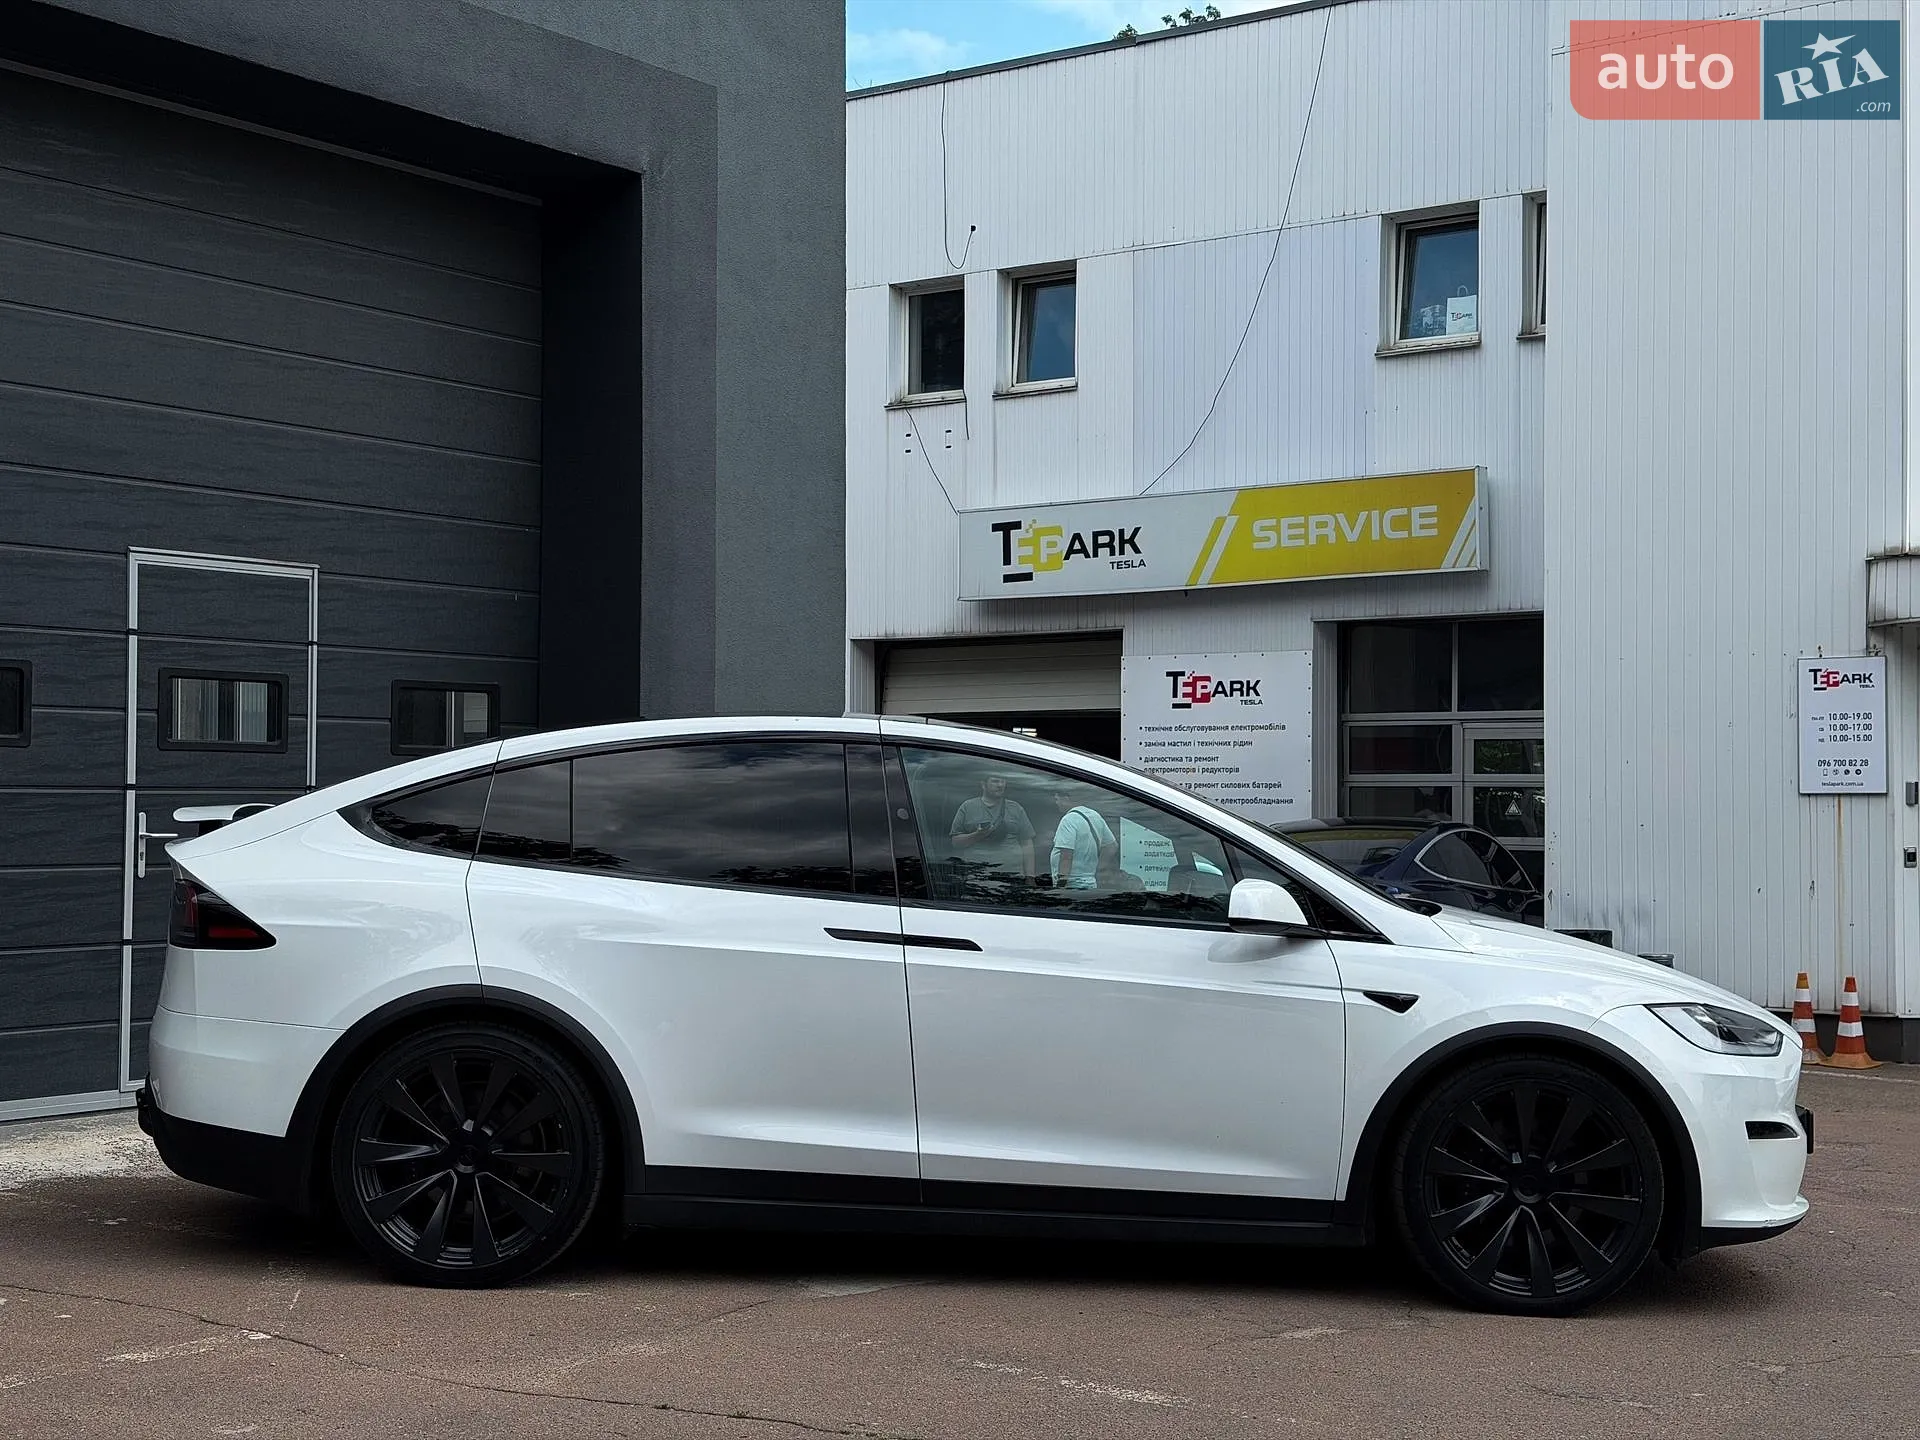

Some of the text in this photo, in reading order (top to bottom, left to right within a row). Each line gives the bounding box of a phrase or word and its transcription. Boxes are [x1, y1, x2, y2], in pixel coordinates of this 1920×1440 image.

[1252, 505, 1439, 550] SERVICE
[1109, 558, 1147, 570] TESLA
[1828, 712, 1873, 721] 10.00-19.00
[1144, 723, 1286, 733] технічне обслуговування електромобілів
[1828, 723, 1873, 731] 10.00-17.00
[1828, 734, 1873, 742] 10.00-15.00
[1144, 740, 1166, 748] заміна
[1232, 739, 1253, 749] рідин
[1143, 755, 1183, 764] діагностика
[1194, 755, 1219, 764] ремонт
[1817, 759, 1832, 767] 096
[1833, 759, 1847, 767] 700
[1201, 765, 1240, 775] редукторів
[1194, 782, 1219, 790] ремонт
[1220, 781, 1251, 789] силових
[1252, 780, 1282, 790] батарей
[1220, 797, 1294, 805] електрообладнання
